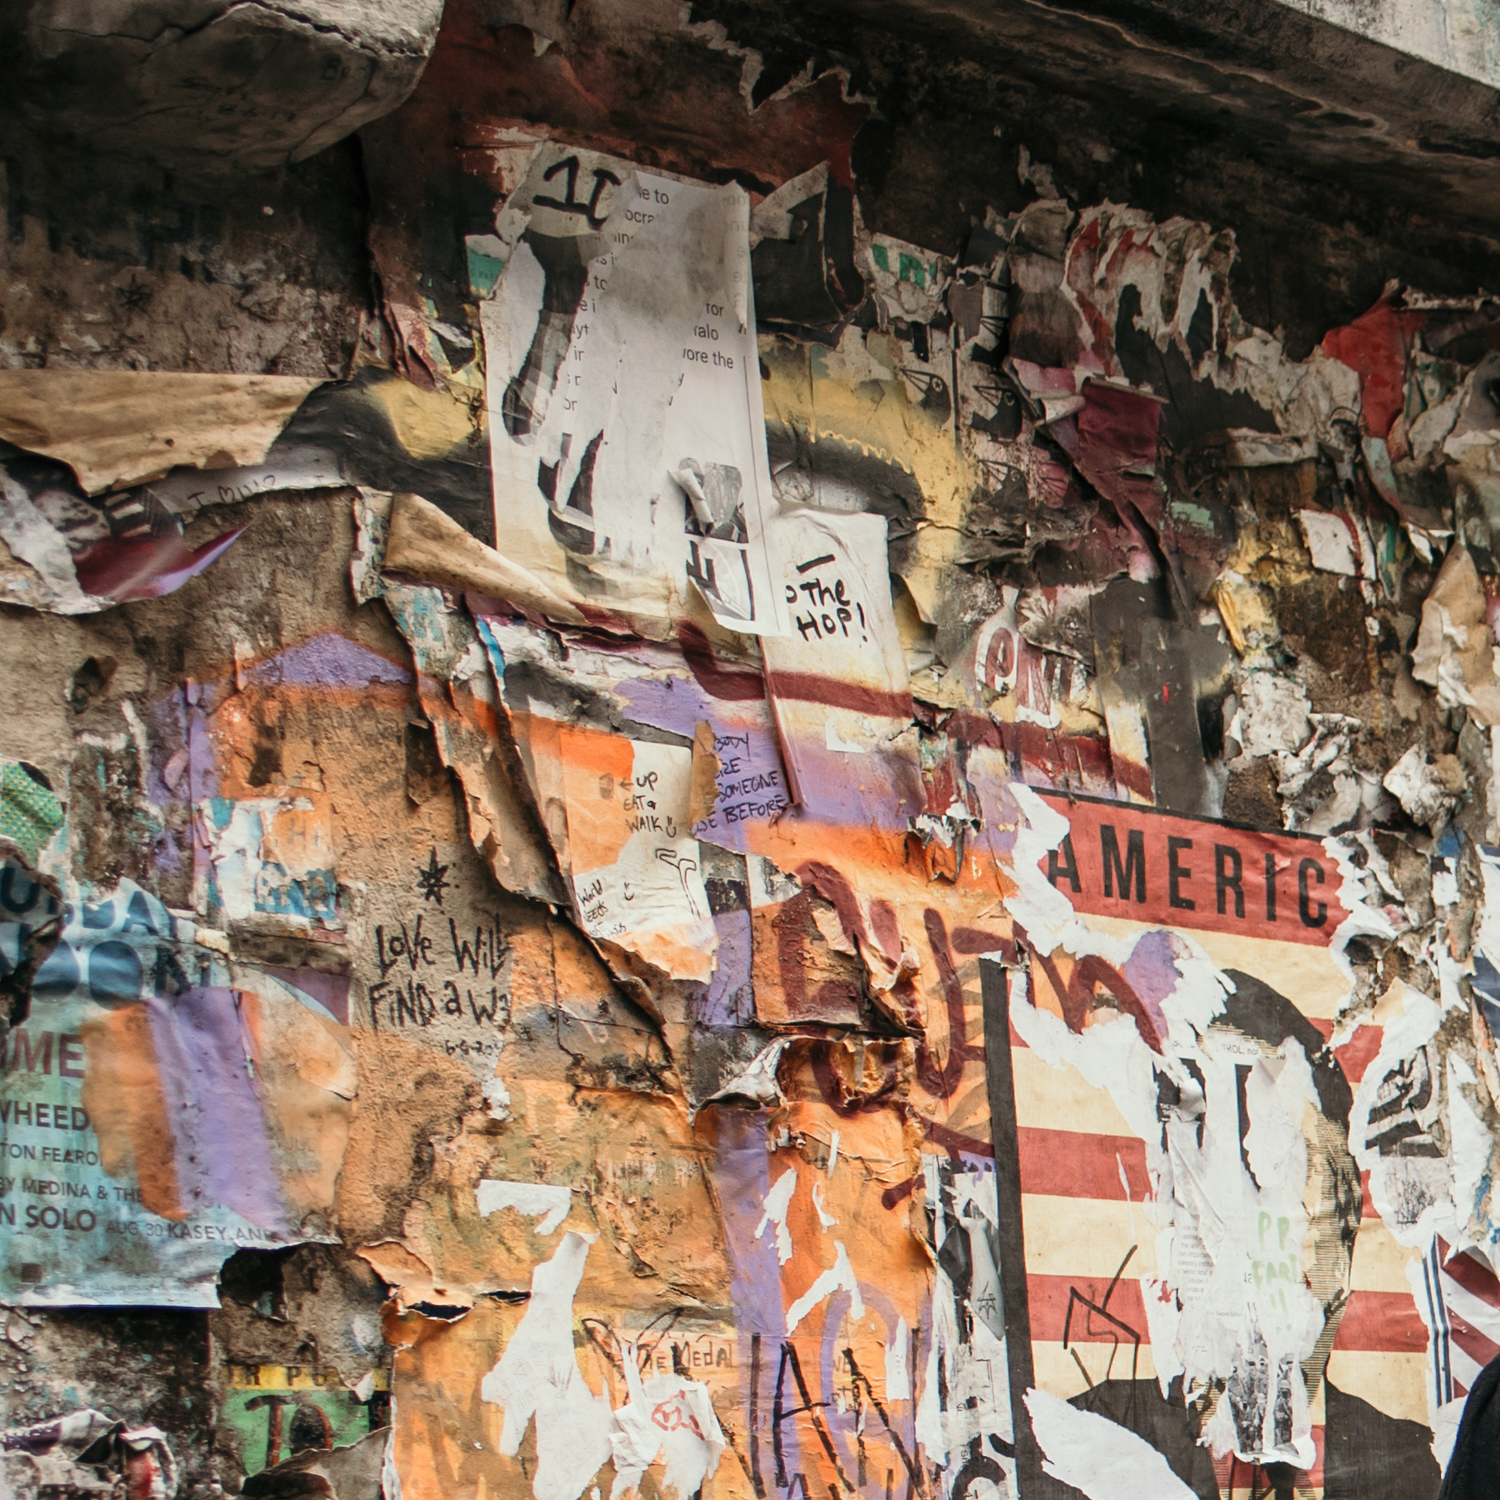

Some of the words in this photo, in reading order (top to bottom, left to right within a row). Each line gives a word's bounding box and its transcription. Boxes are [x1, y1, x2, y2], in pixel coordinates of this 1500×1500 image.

[712, 351, 734, 369] the
[796, 601, 868, 643] HOP!
[1046, 823, 1328, 929] AMERIC
[22, 1178, 89, 1200] MEDINA
[26, 1204, 98, 1234] SOLO
[167, 1223, 228, 1241] KASEY
